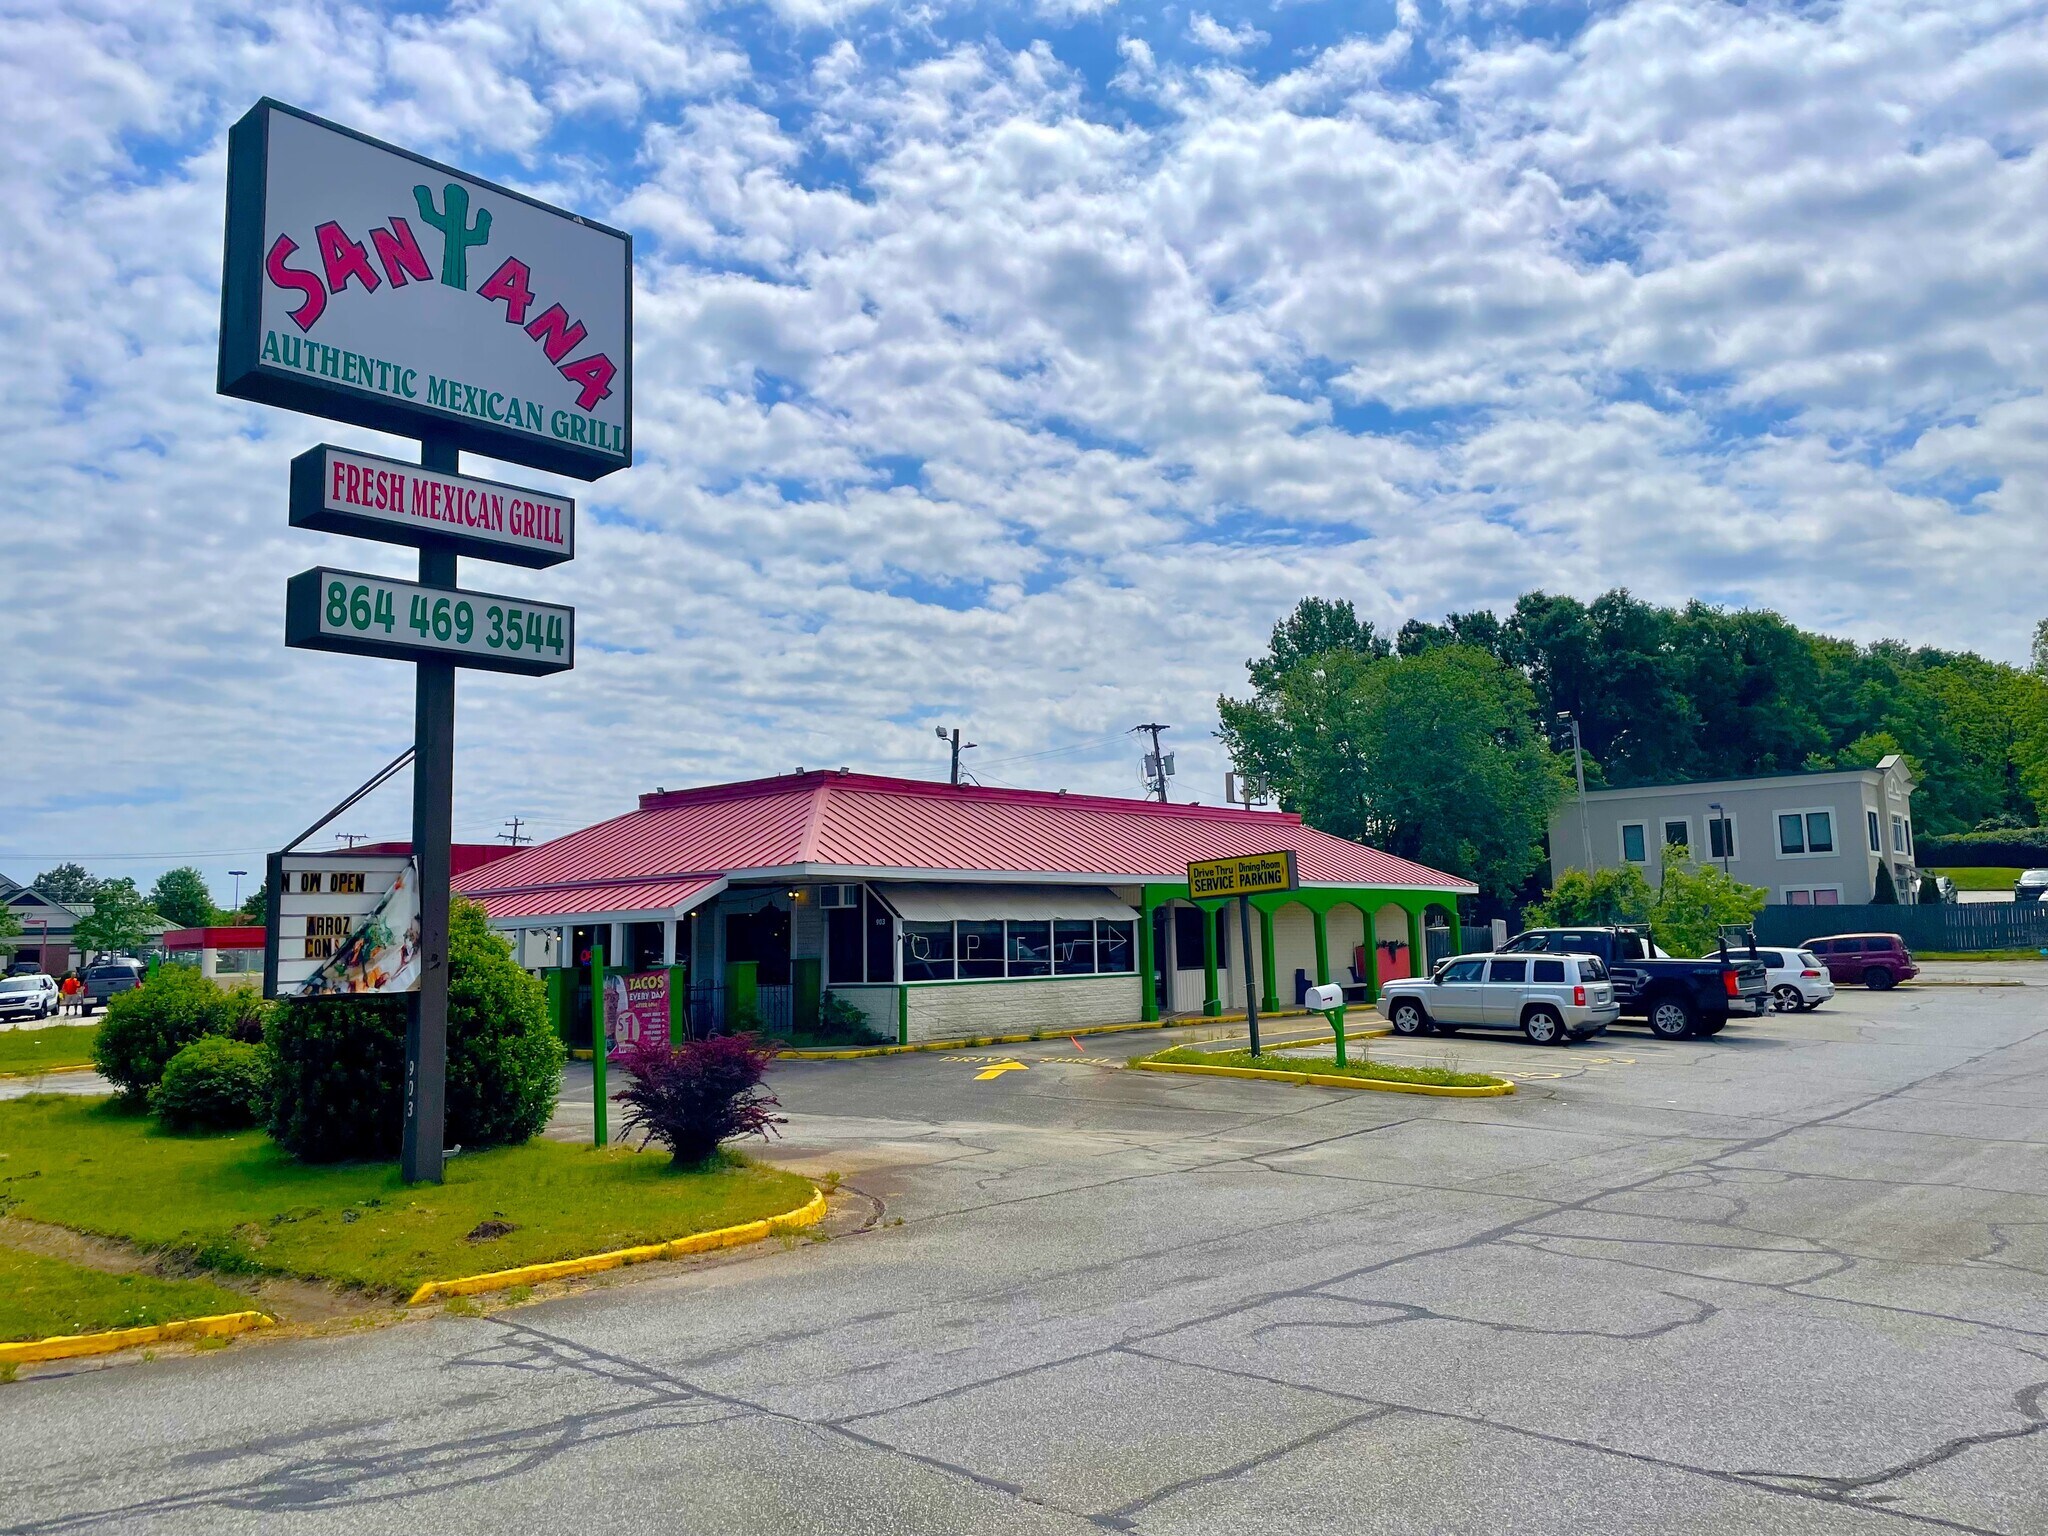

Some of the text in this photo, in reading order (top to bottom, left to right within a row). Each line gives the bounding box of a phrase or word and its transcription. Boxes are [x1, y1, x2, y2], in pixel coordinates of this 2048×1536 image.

[261, 331, 625, 453] AUTHENTIC MEXICAN GRILL
[333, 461, 564, 545] FRESH MEXICAN GRILL
[326, 581, 564, 656] 864 469 3544
[1193, 865, 1234, 878] Drive Thru
[1238, 860, 1280, 873] Dining Room
[331, 873, 365, 892] OPEN
[1195, 875, 1234, 892] SERVICE
[1239, 870, 1282, 887] PARKING
[307, 916, 350, 935] ARROZ
[875, 918, 886, 926] 903
[305, 938, 332, 958] CON
[629, 975, 665, 990] TACOS
[629, 990, 665, 1001] EVERY DAY
